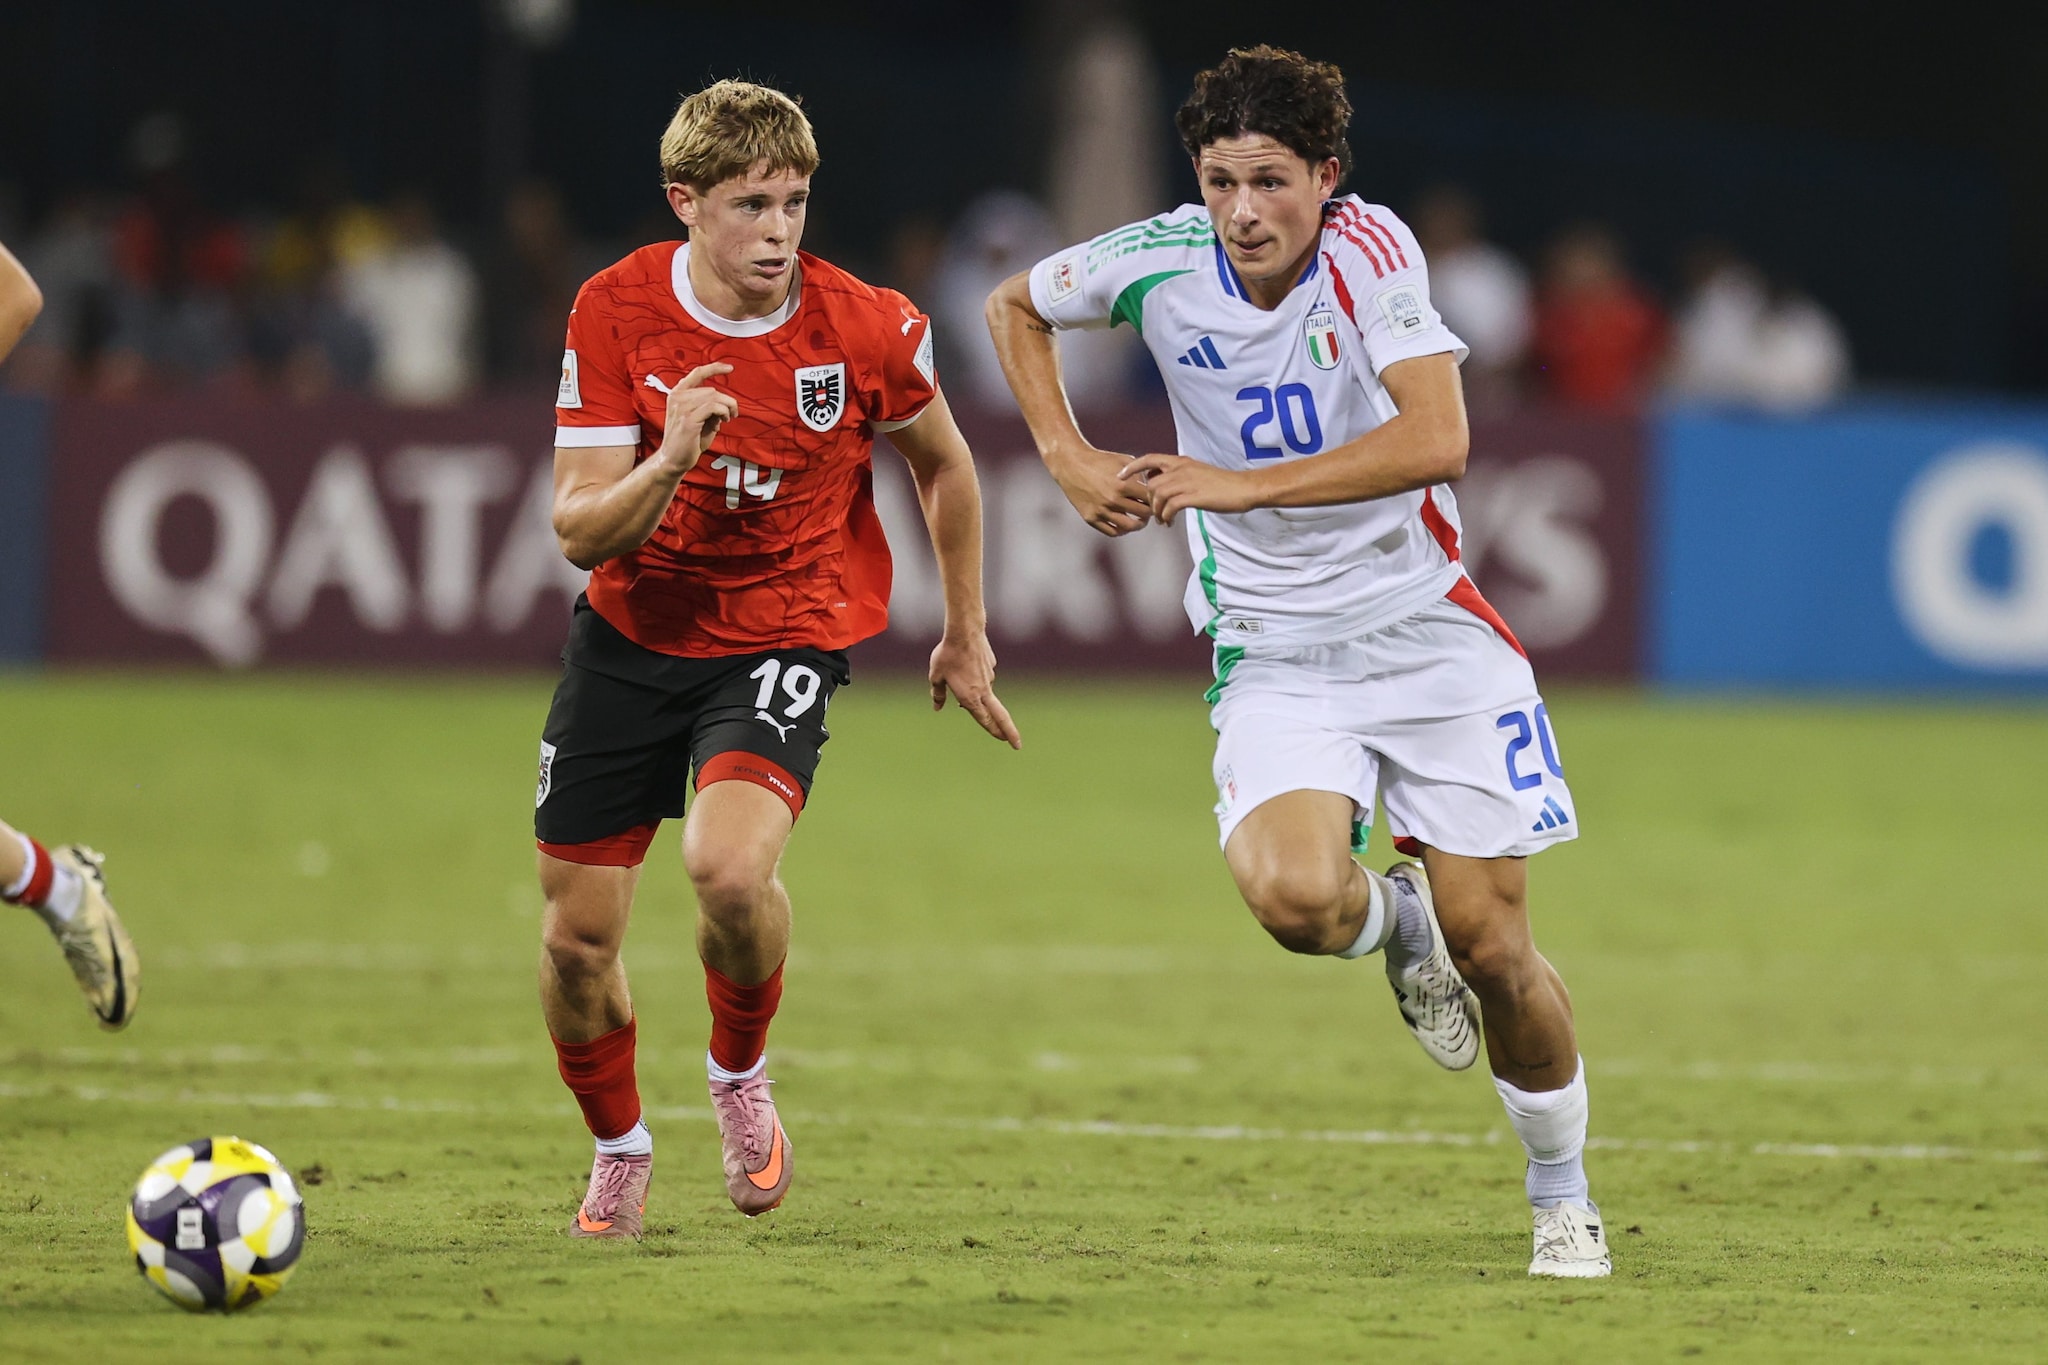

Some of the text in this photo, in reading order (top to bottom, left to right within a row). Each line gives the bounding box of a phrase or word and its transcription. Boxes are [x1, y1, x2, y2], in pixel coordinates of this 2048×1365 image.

[1306, 316, 1333, 330] ITALIA
[1236, 382, 1324, 460] 20
[100, 438, 588, 667] QATA
[750, 658, 822, 719] 19
